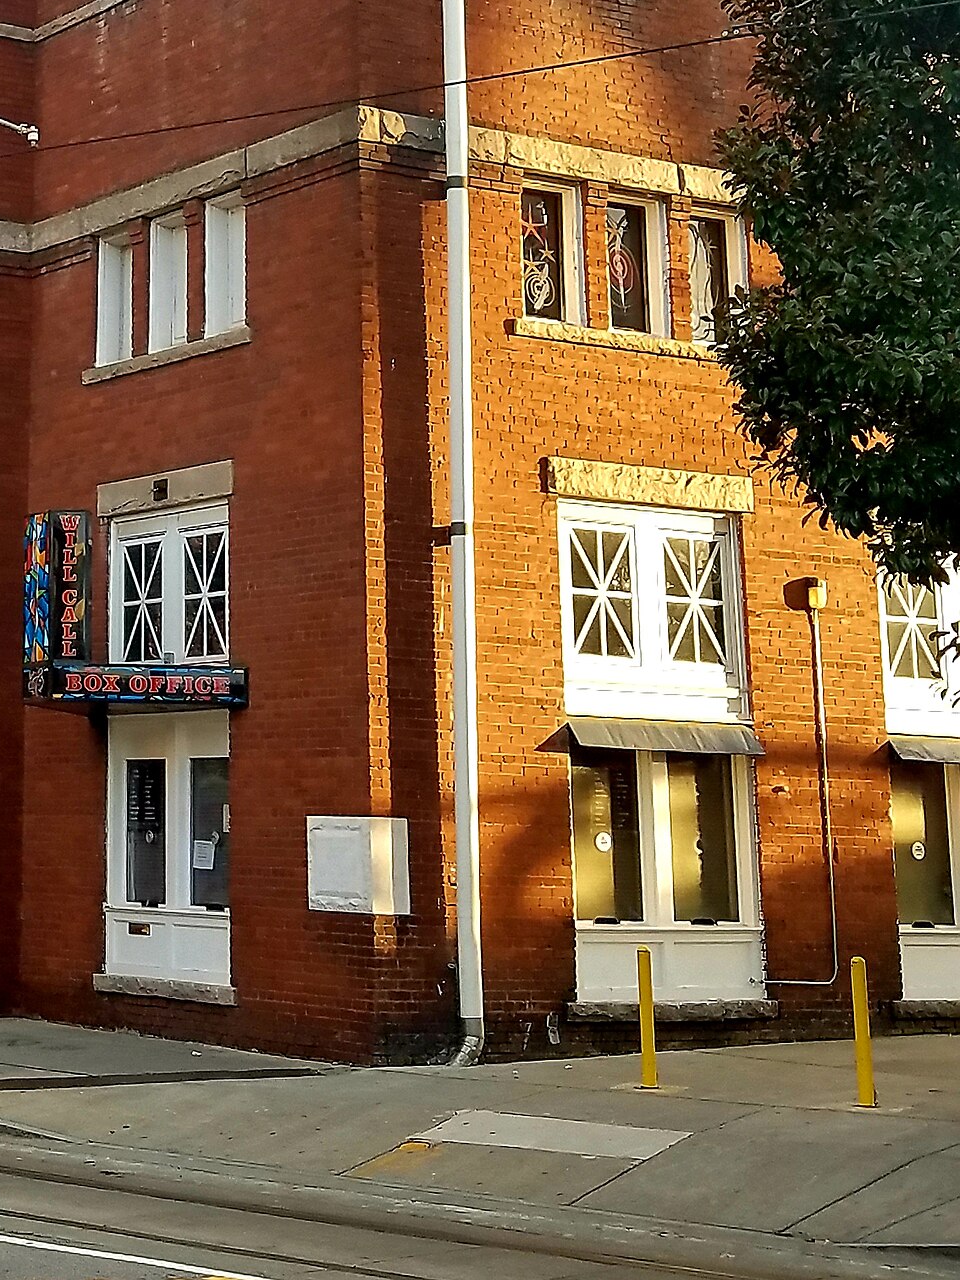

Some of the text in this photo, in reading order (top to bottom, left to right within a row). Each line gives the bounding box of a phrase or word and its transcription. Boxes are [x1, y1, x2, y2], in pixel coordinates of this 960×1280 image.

[59, 514, 81, 657] WILL CALL
[65, 673, 231, 695] BOX OFFICE
